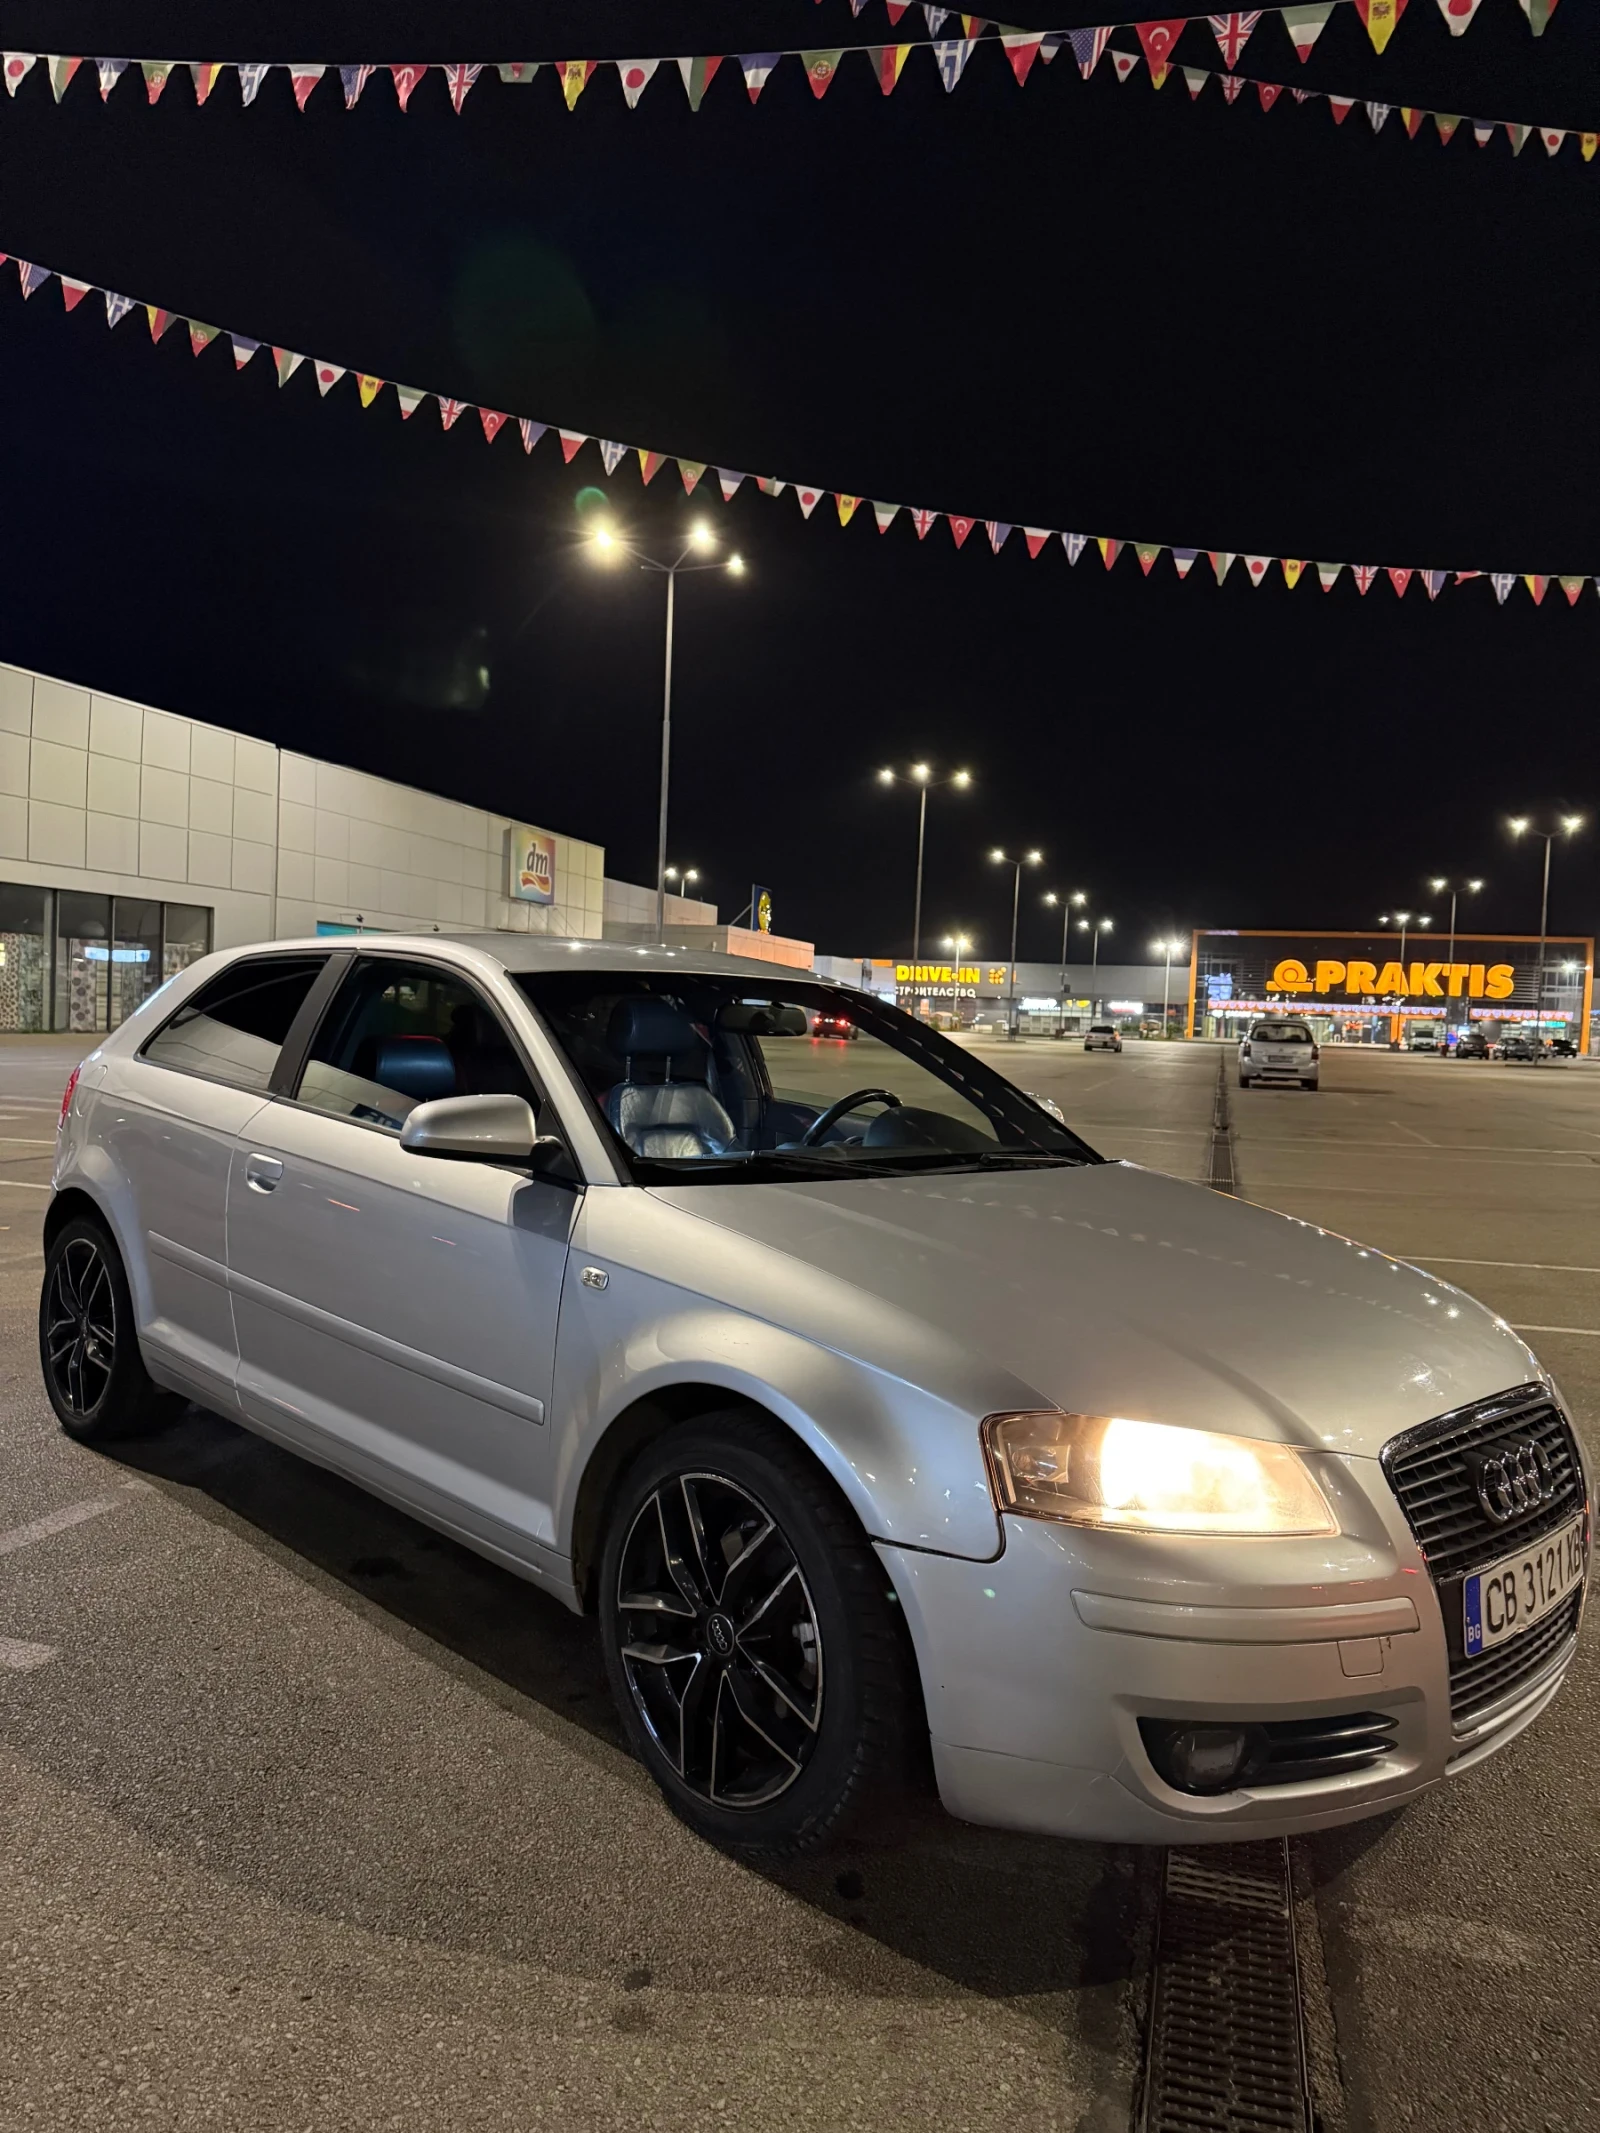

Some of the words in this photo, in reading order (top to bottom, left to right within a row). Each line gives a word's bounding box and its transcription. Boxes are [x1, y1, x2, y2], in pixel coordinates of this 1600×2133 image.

[526, 842, 549, 876] dm
[896, 965, 981, 983] DRIVE-IN
[1315, 960, 1515, 999] PRAKTIS
[1486, 1571, 1518, 1634] CB
[1523, 1539, 1564, 1614] 3121
[1467, 1623, 1481, 1643] BG
